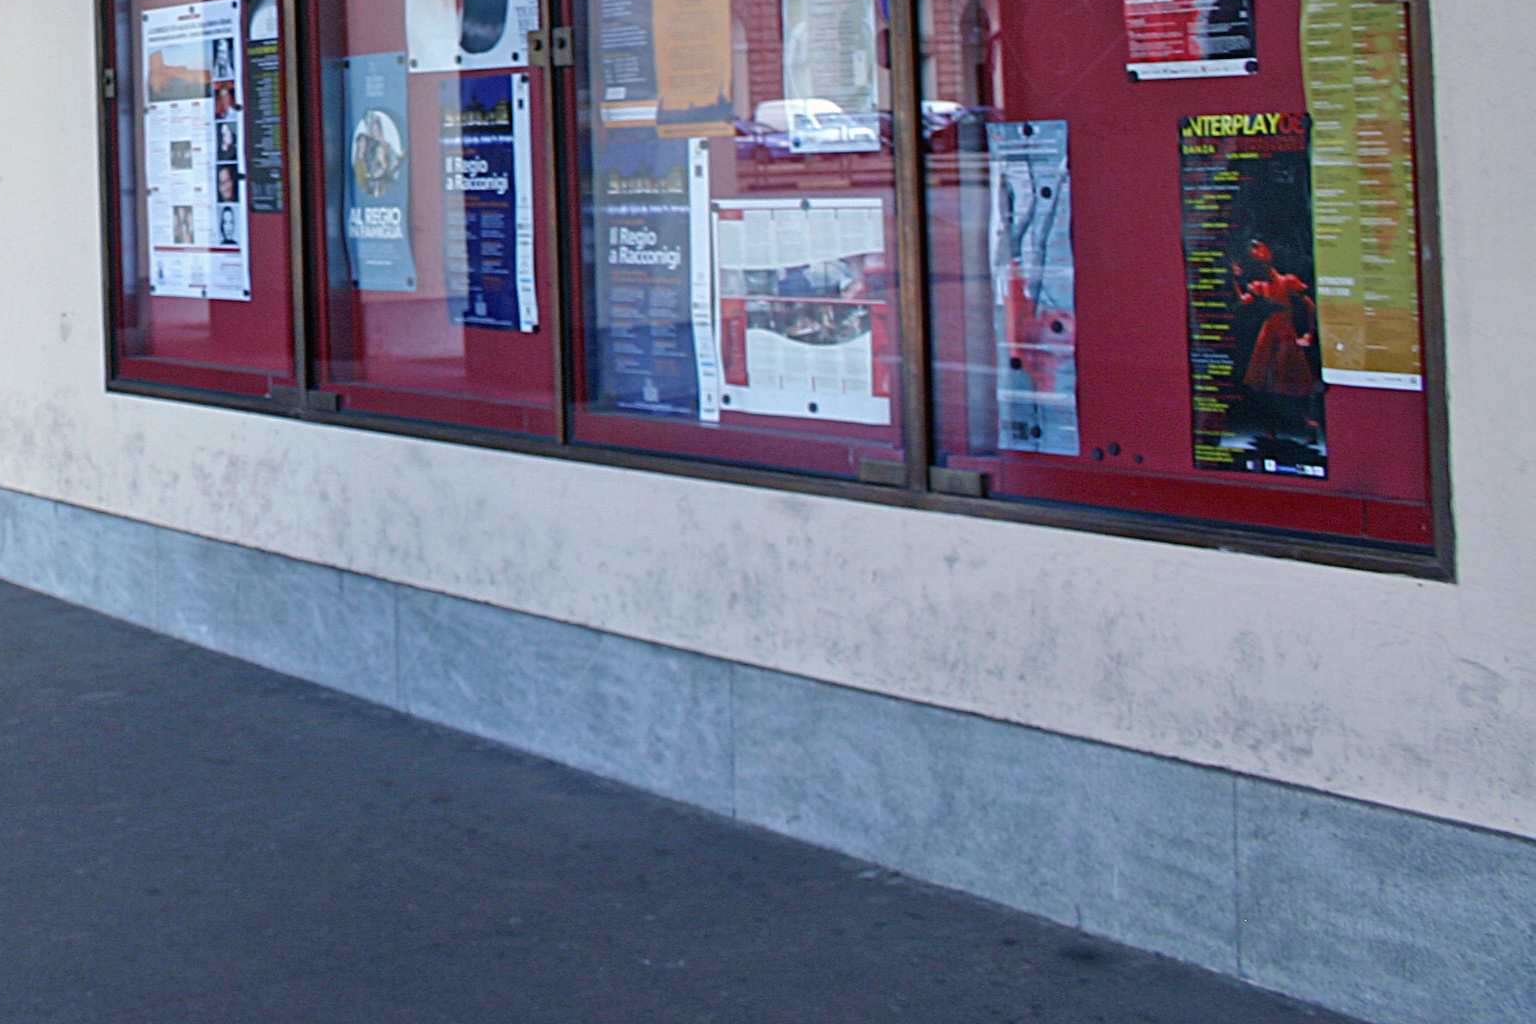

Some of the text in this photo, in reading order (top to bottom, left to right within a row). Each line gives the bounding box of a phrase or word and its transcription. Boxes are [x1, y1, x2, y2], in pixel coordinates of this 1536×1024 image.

[454, 155, 489, 177] Regio
[618, 227, 658, 250] Regio
[619, 246, 682, 270] Racconigi
